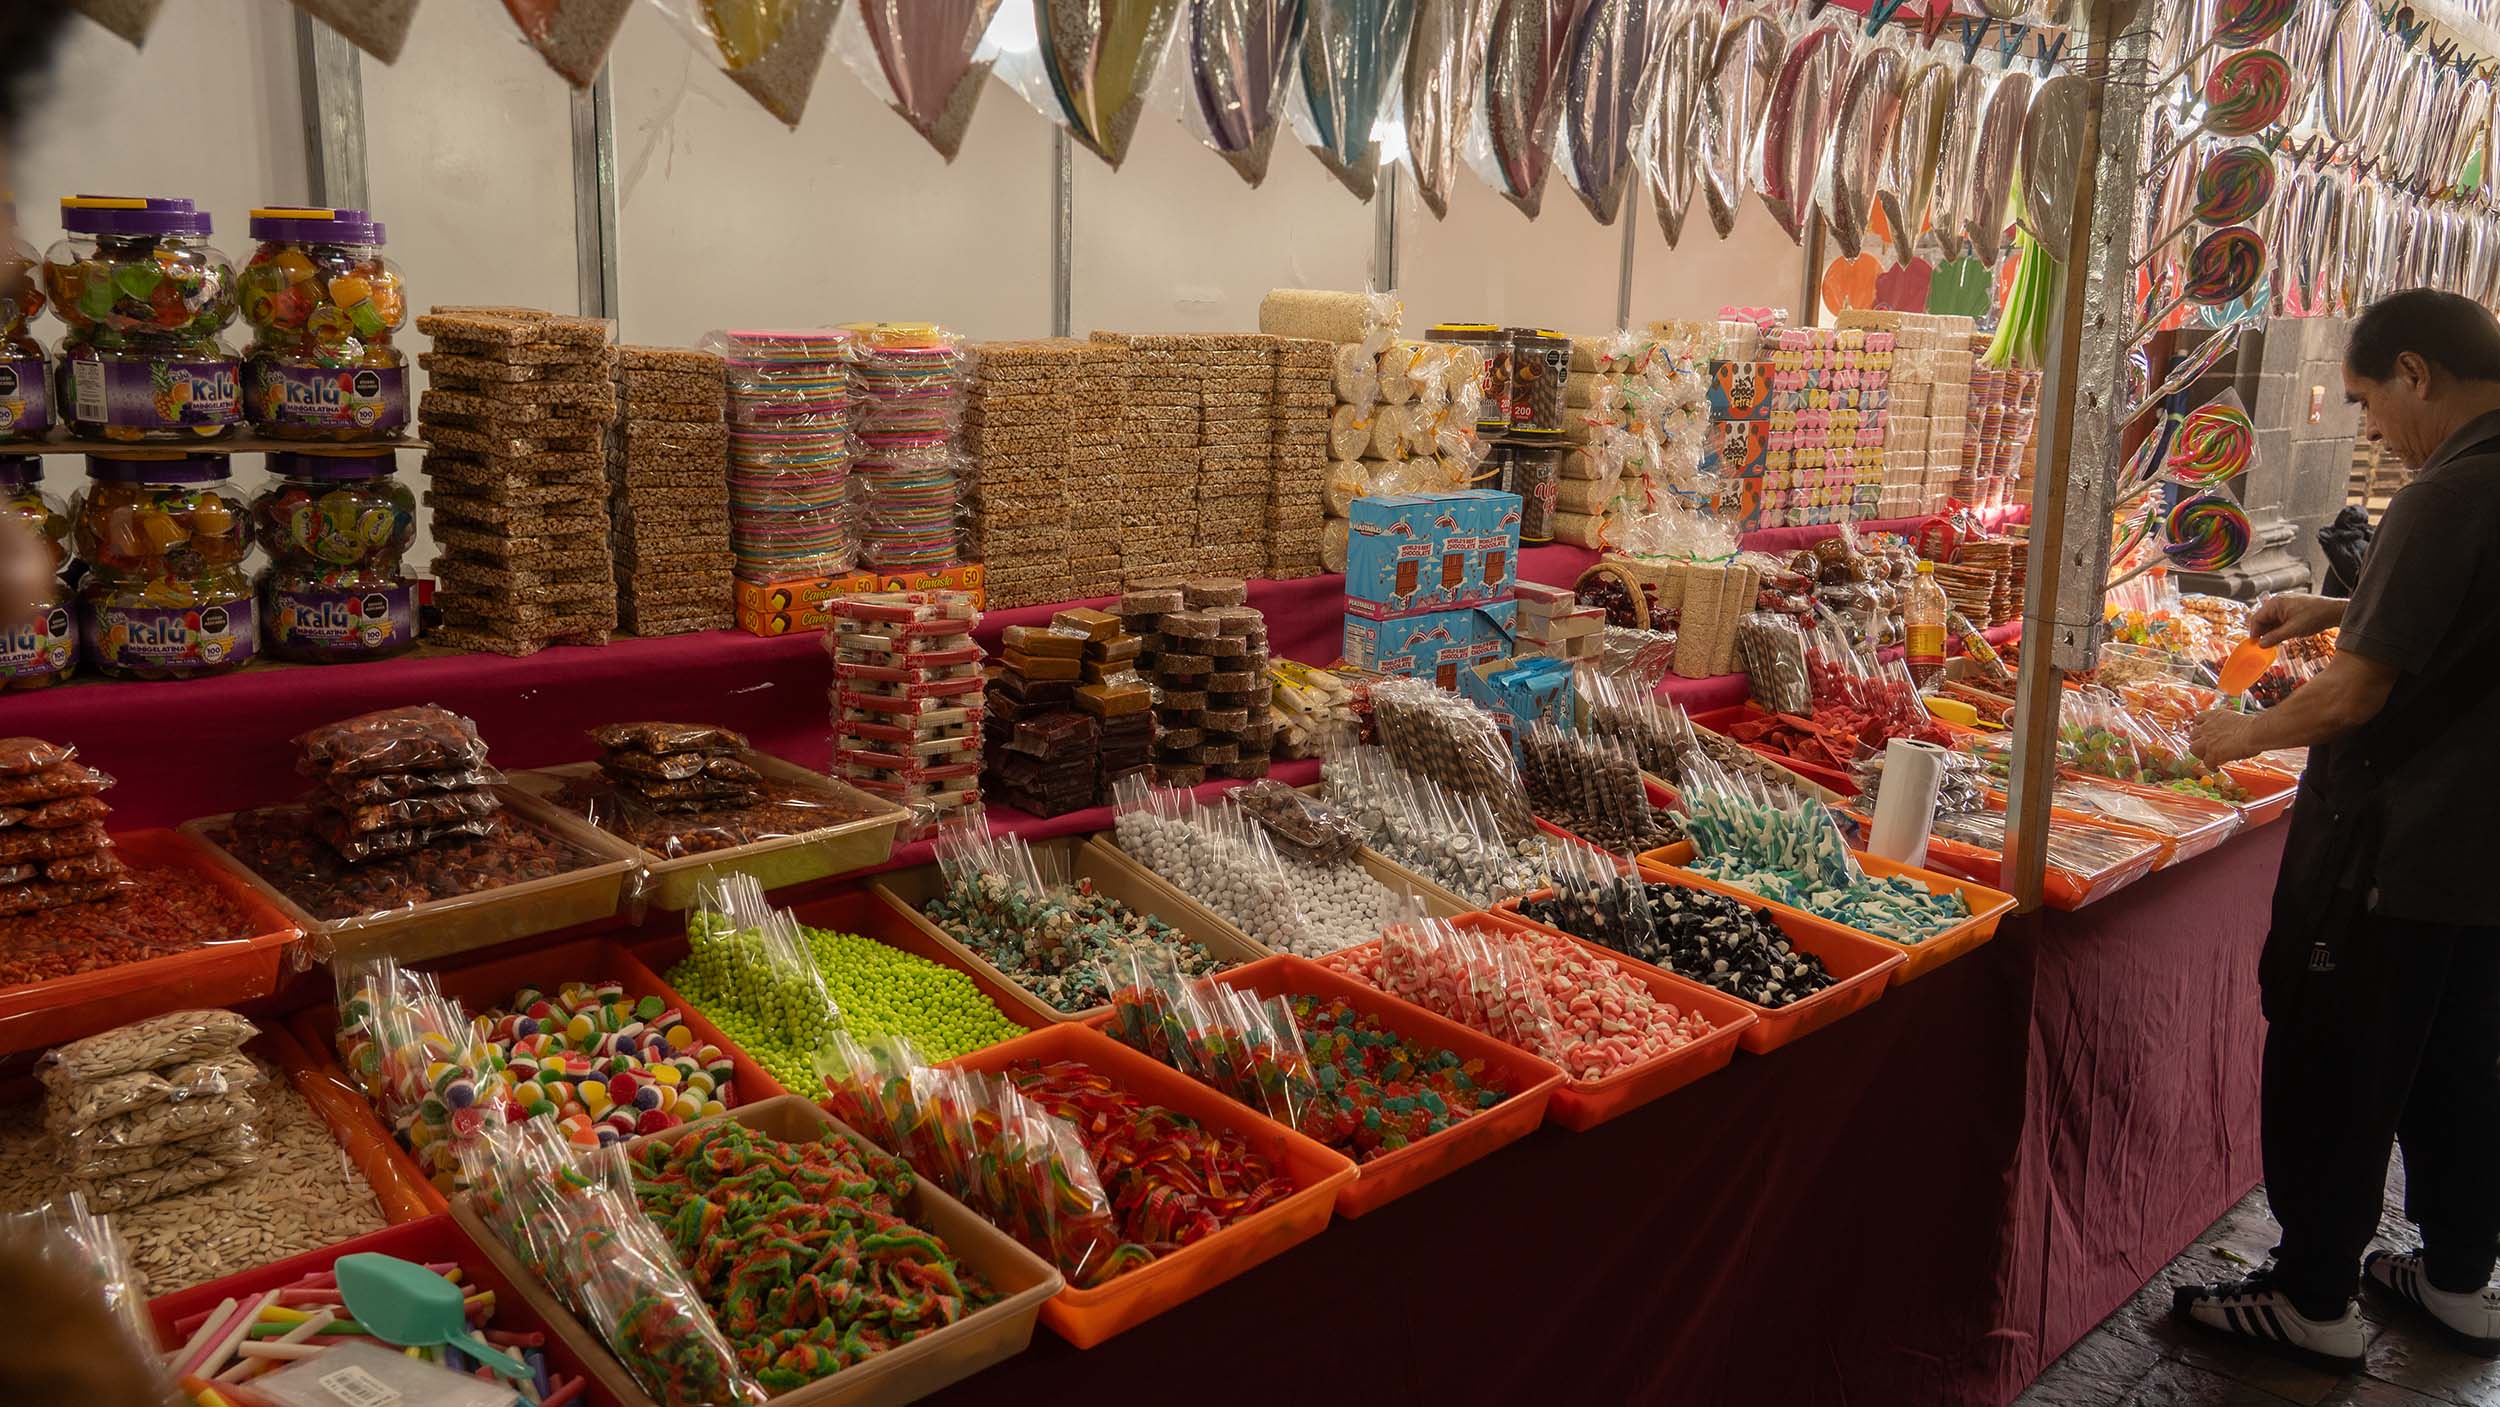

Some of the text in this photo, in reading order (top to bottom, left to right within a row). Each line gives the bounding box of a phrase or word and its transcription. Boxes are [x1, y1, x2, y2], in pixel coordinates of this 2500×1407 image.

[190, 371, 235, 402] Kalú
[284, 376, 341, 404] Kalú
[287, 404, 340, 413] MINIGELATINA
[1514, 406, 1531, 416] 200
[359, 410, 373, 418] 100
[1479, 541, 1506, 550] CHOCOLATE
[964, 570, 978, 583] 50
[915, 575, 953, 591] Canasta
[747, 589, 758, 605] 50
[295, 601, 350, 629] Kalú
[747, 611, 758, 626] 50
[127, 617, 187, 646] Kalú
[298, 627, 348, 635] MINIGELATINA
[0, 624, 36, 655] alú
[129, 644, 187, 654] MINIGELATINA
[206, 646, 221, 655] 100
[1471, 645, 1498, 655] CHOCOLATE
[54, 650, 66, 659] 100
[1441, 652, 1468, 660] CHOCOLATE
[1381, 661, 1412, 671] CHOCOLATE
